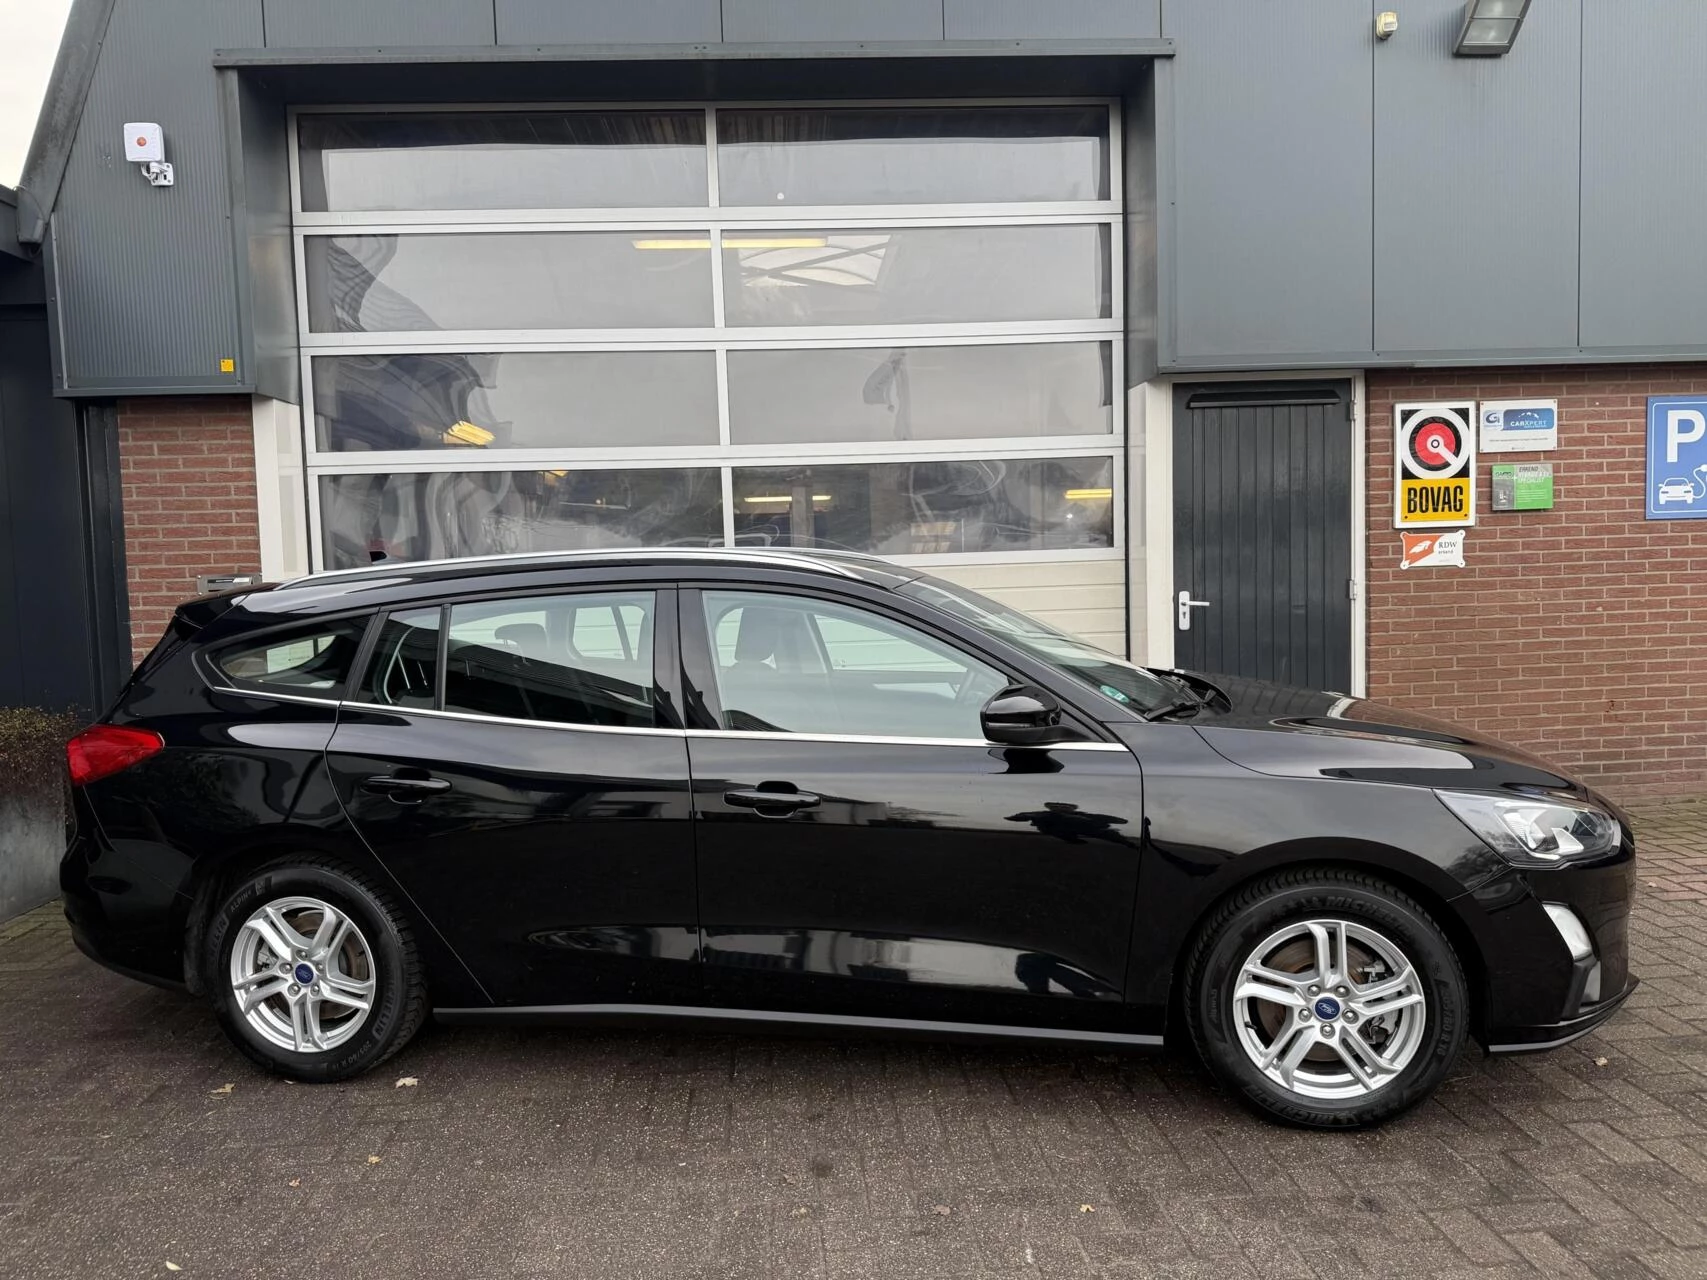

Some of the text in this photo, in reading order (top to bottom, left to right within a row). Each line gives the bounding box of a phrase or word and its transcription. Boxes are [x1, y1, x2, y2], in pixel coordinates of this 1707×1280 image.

[1666, 409, 1706, 463] P
[1407, 485, 1464, 514] BOVAG
[1438, 541, 1458, 549] RDW
